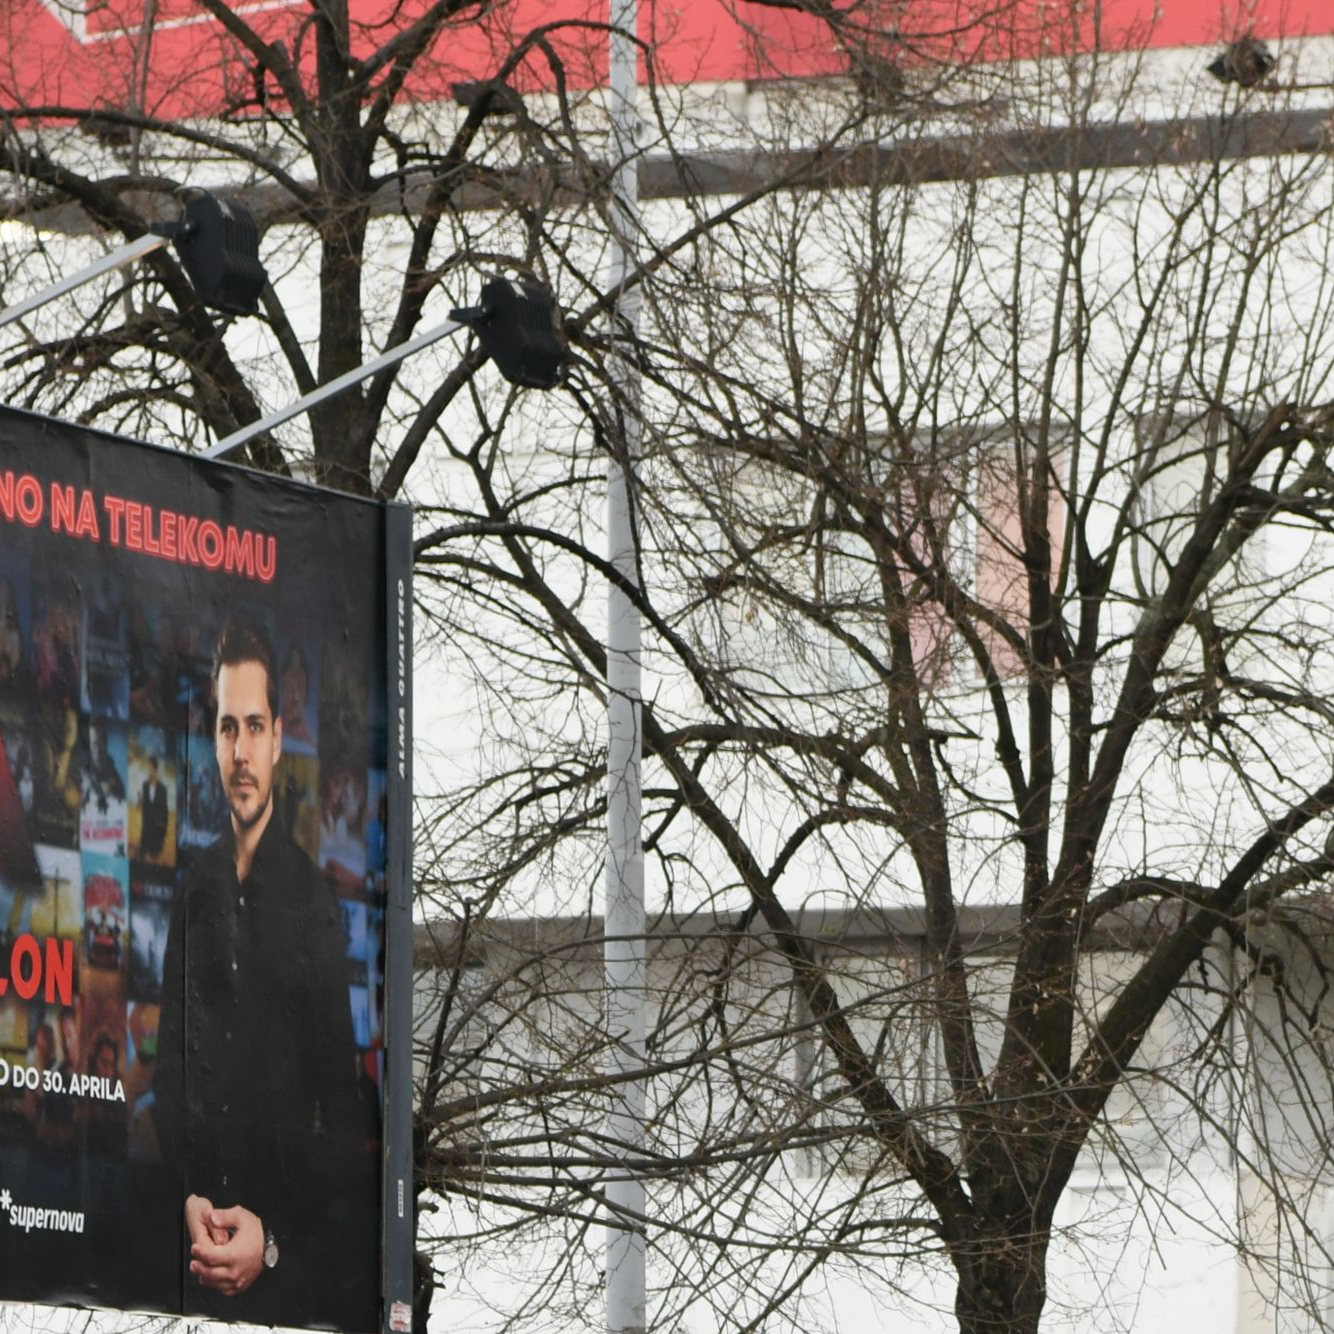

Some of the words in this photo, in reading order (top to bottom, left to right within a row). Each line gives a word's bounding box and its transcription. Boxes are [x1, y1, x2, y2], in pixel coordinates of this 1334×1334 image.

[51, 481, 101, 543] NA
[103, 495, 277, 584] TELEKOMU
[397, 579, 407, 698] QUATTRO
[397, 708, 406, 779] ALMA
[12, 1067, 40, 1090] DO
[42, 1069, 67, 1094] 30.
[69, 1072, 126, 1103] APRILA
[9, 1201, 85, 1233] supernova
